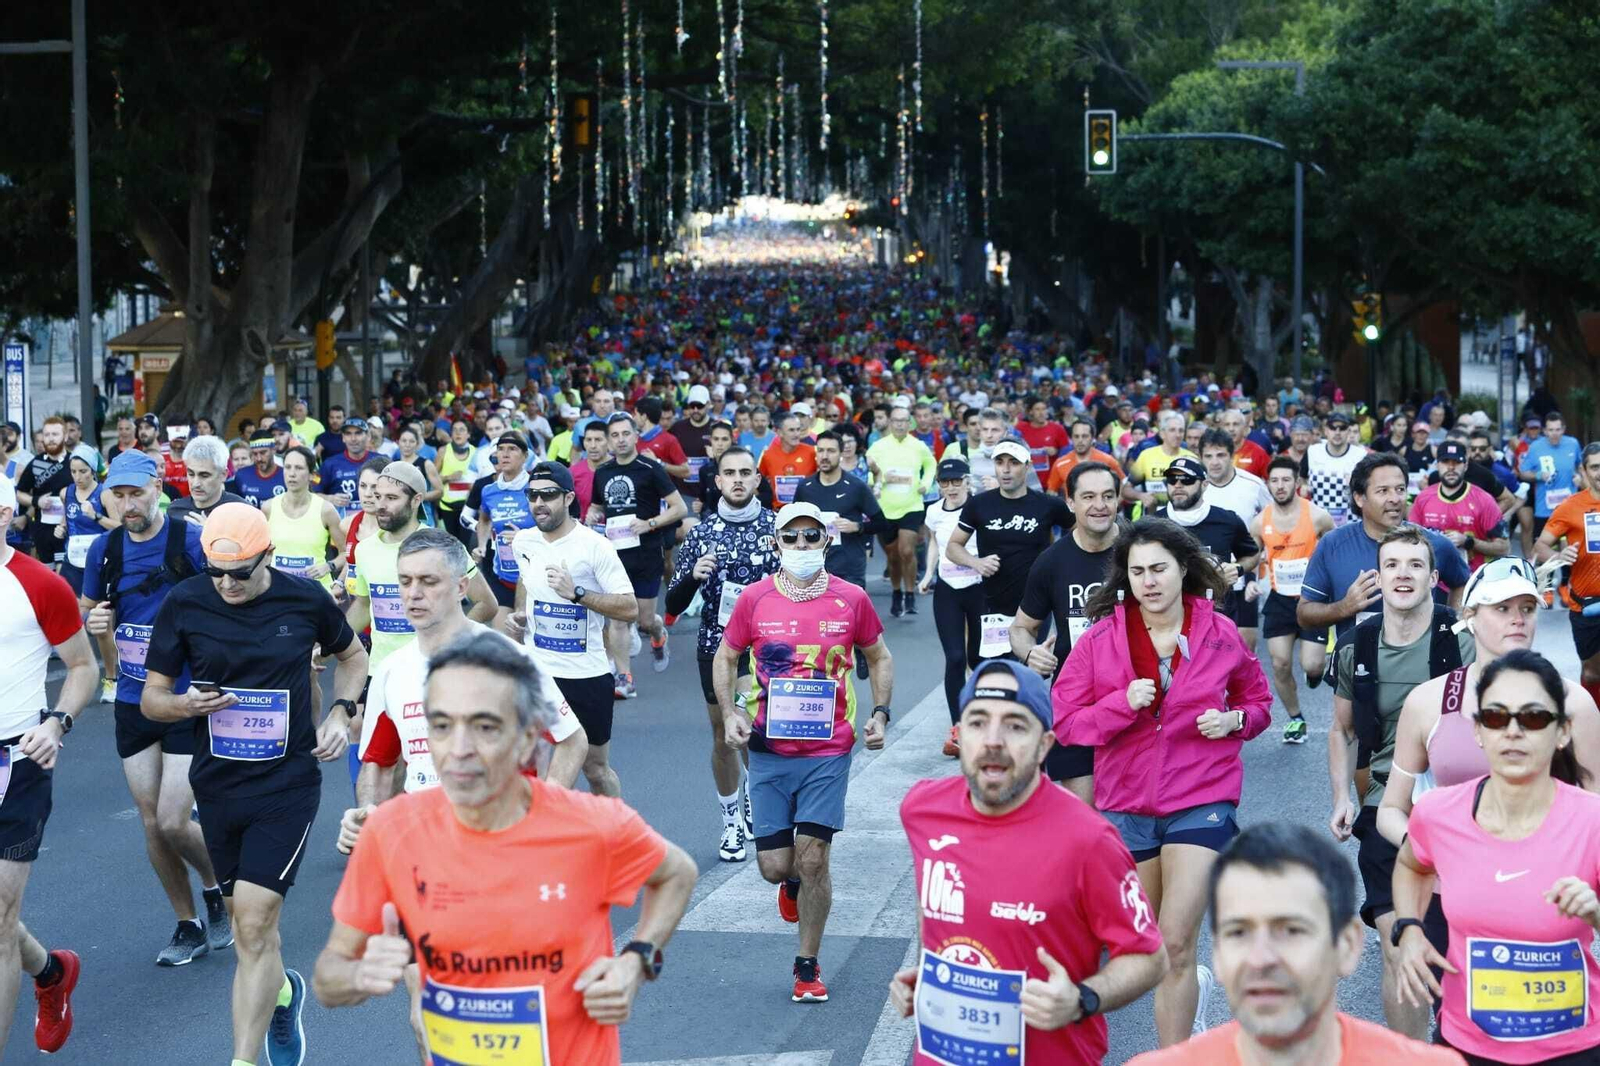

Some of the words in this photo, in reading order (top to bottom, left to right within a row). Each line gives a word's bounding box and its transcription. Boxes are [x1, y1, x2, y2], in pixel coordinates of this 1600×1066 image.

[6, 348, 22, 360] BUS
[552, 606, 577, 614] ZURICH
[554, 622, 579, 631] 4249
[795, 684, 823, 692] ZURICH
[1446, 670, 1464, 711] PRO
[239, 696, 272, 704] ZURICH
[799, 702, 824, 712] 2386
[243, 717, 275, 728] 2784
[451, 948, 564, 974] Running
[1513, 950, 1561, 962] ZURICH
[952, 971, 999, 991] ZURICH
[1522, 980, 1567, 995] 1303
[457, 998, 514, 1012] ZURICH
[958, 1005, 1001, 1026] 3831
[470, 1032, 521, 1050] 1577
